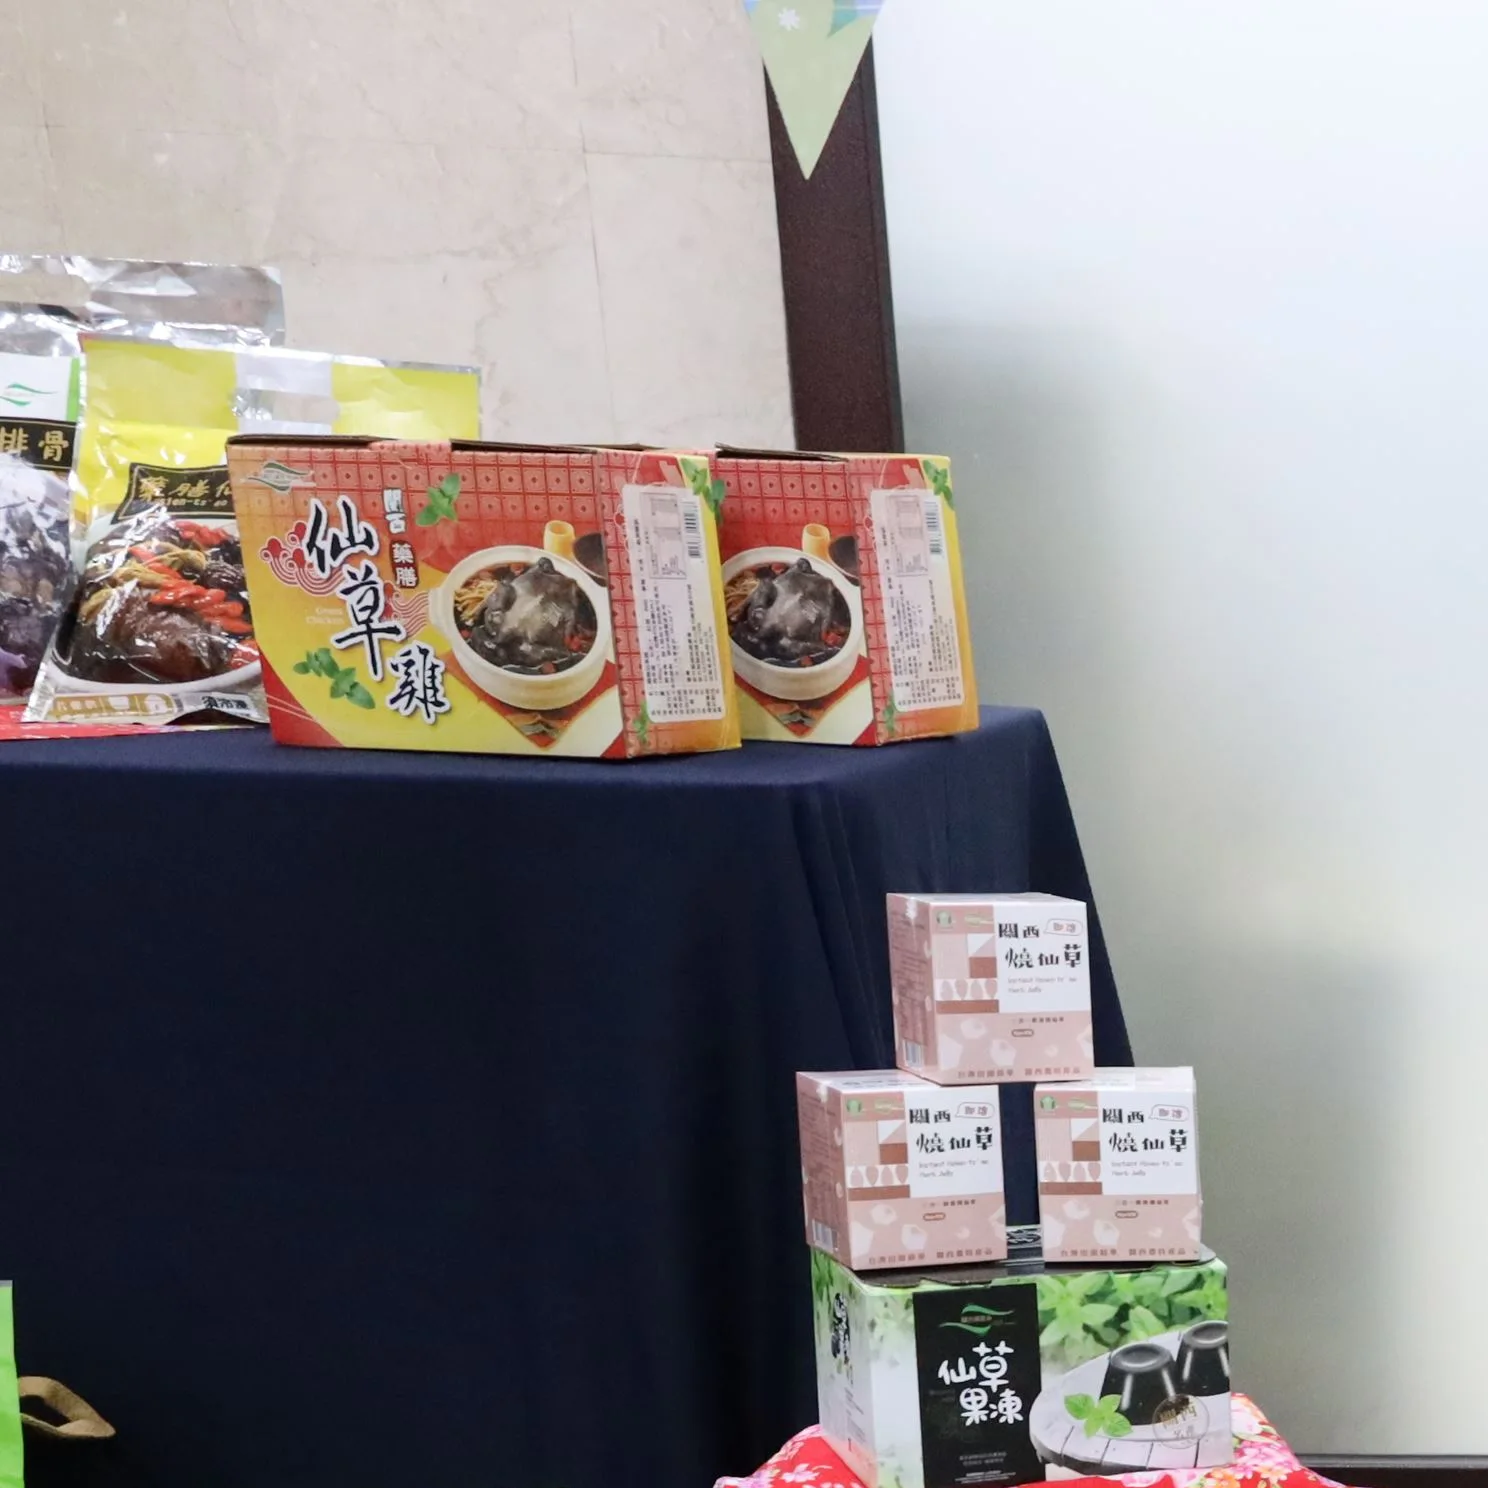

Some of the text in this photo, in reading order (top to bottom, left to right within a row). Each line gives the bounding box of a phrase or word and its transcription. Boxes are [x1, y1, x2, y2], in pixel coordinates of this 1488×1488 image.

[305, 499, 451, 721] 仙草雞
[998, 923, 1040, 938] 關西
[1004, 943, 1082, 968] 燒仙草
[909, 1108, 951, 1124] 關西
[1102, 1108, 1145, 1124] 關西
[916, 1126, 993, 1153] 燒仙草
[1108, 1129, 1188, 1153] 燒仙草
[938, 1340, 1015, 1393] 仙草
[959, 1387, 1024, 1426] 果凍
